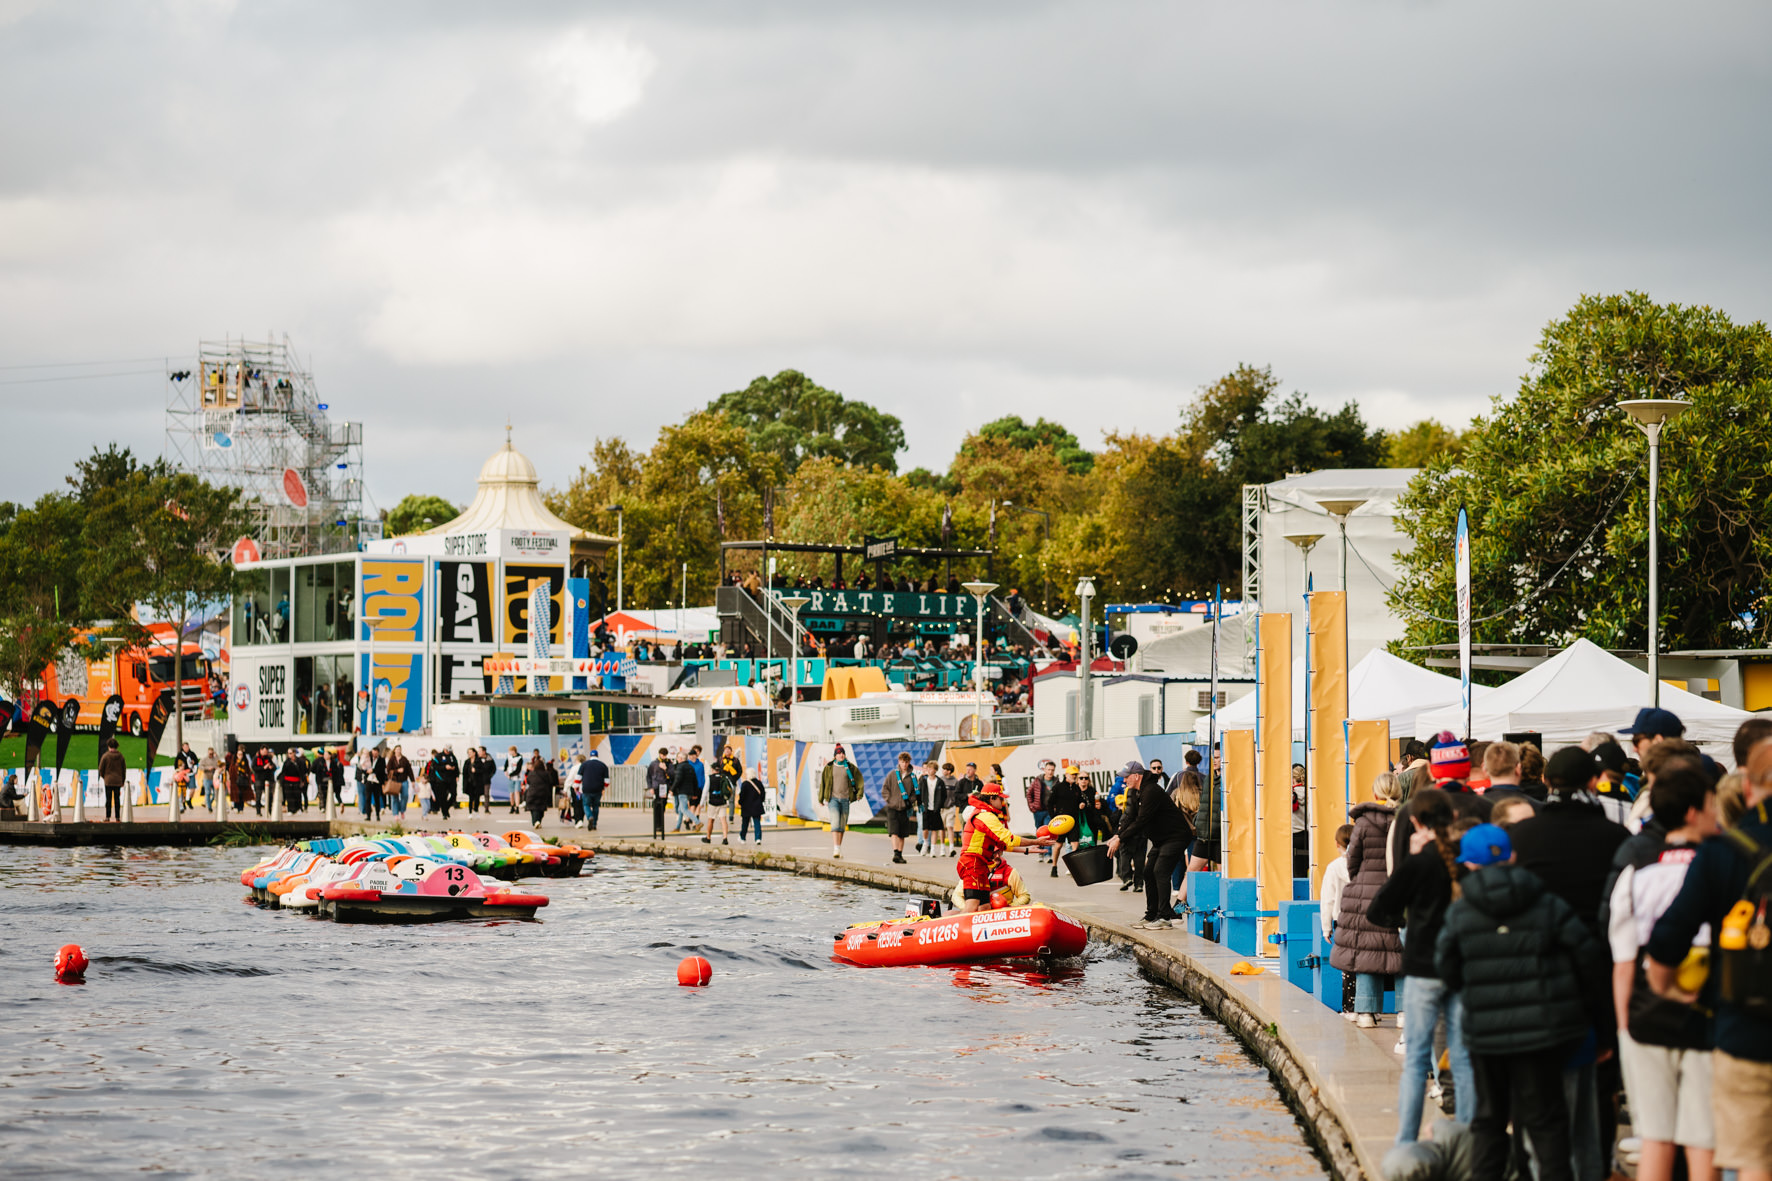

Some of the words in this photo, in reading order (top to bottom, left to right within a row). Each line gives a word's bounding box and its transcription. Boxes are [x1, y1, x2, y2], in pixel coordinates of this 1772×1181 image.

[445, 536, 465, 555] SUPER
[467, 533, 487, 555] STORE
[511, 537, 530, 547] FOOTY
[532, 537, 558, 548] FESTIVAL
[450, 563, 486, 701] GATHE
[810, 621, 836, 629] BAR
[259, 665, 286, 695] SUPER
[259, 698, 285, 728] STORE
[452, 838, 459, 848] 8
[508, 833, 521, 843] 15
[415, 863, 425, 876] 5
[445, 867, 464, 881] 13
[972, 911, 1007, 924] GOOLWA
[1009, 908, 1032, 920] SLSC
[878, 930, 903, 949] RESCUE
[919, 923, 959, 945] SL126S
[990, 926, 1028, 937] AMPOL
[847, 934, 866, 951] SURF
